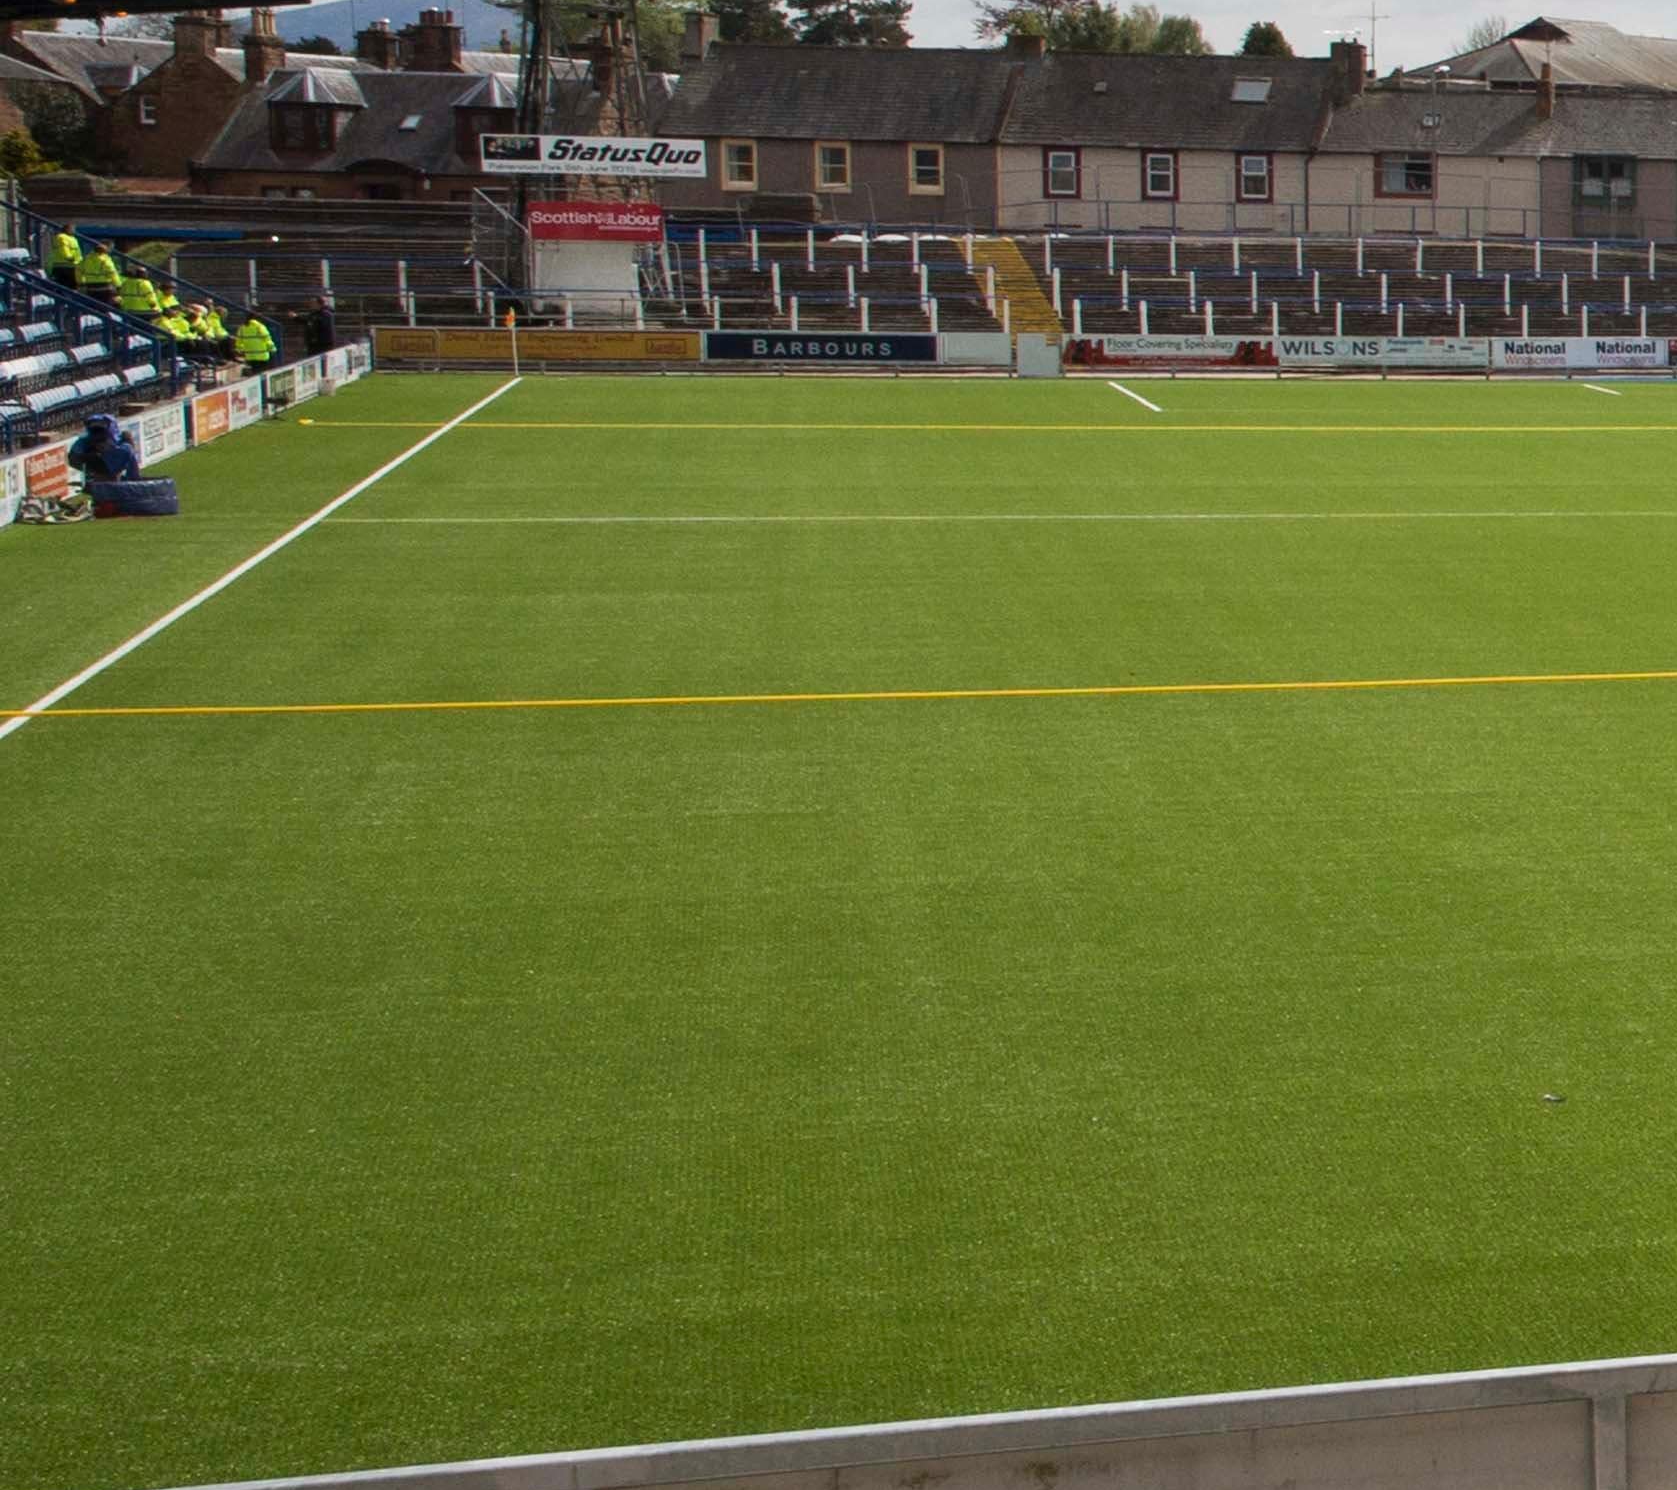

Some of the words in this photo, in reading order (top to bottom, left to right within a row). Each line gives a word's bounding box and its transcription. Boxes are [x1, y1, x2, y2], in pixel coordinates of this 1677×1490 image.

[531, 211, 598, 225] Scottish
[609, 212, 661, 226] Labour
[1106, 338, 1133, 350] Floor
[1136, 338, 1182, 351] Covering
[1281, 340, 1379, 356] WILSONS
[1504, 341, 1566, 355] National
[1596, 341, 1656, 354] National
